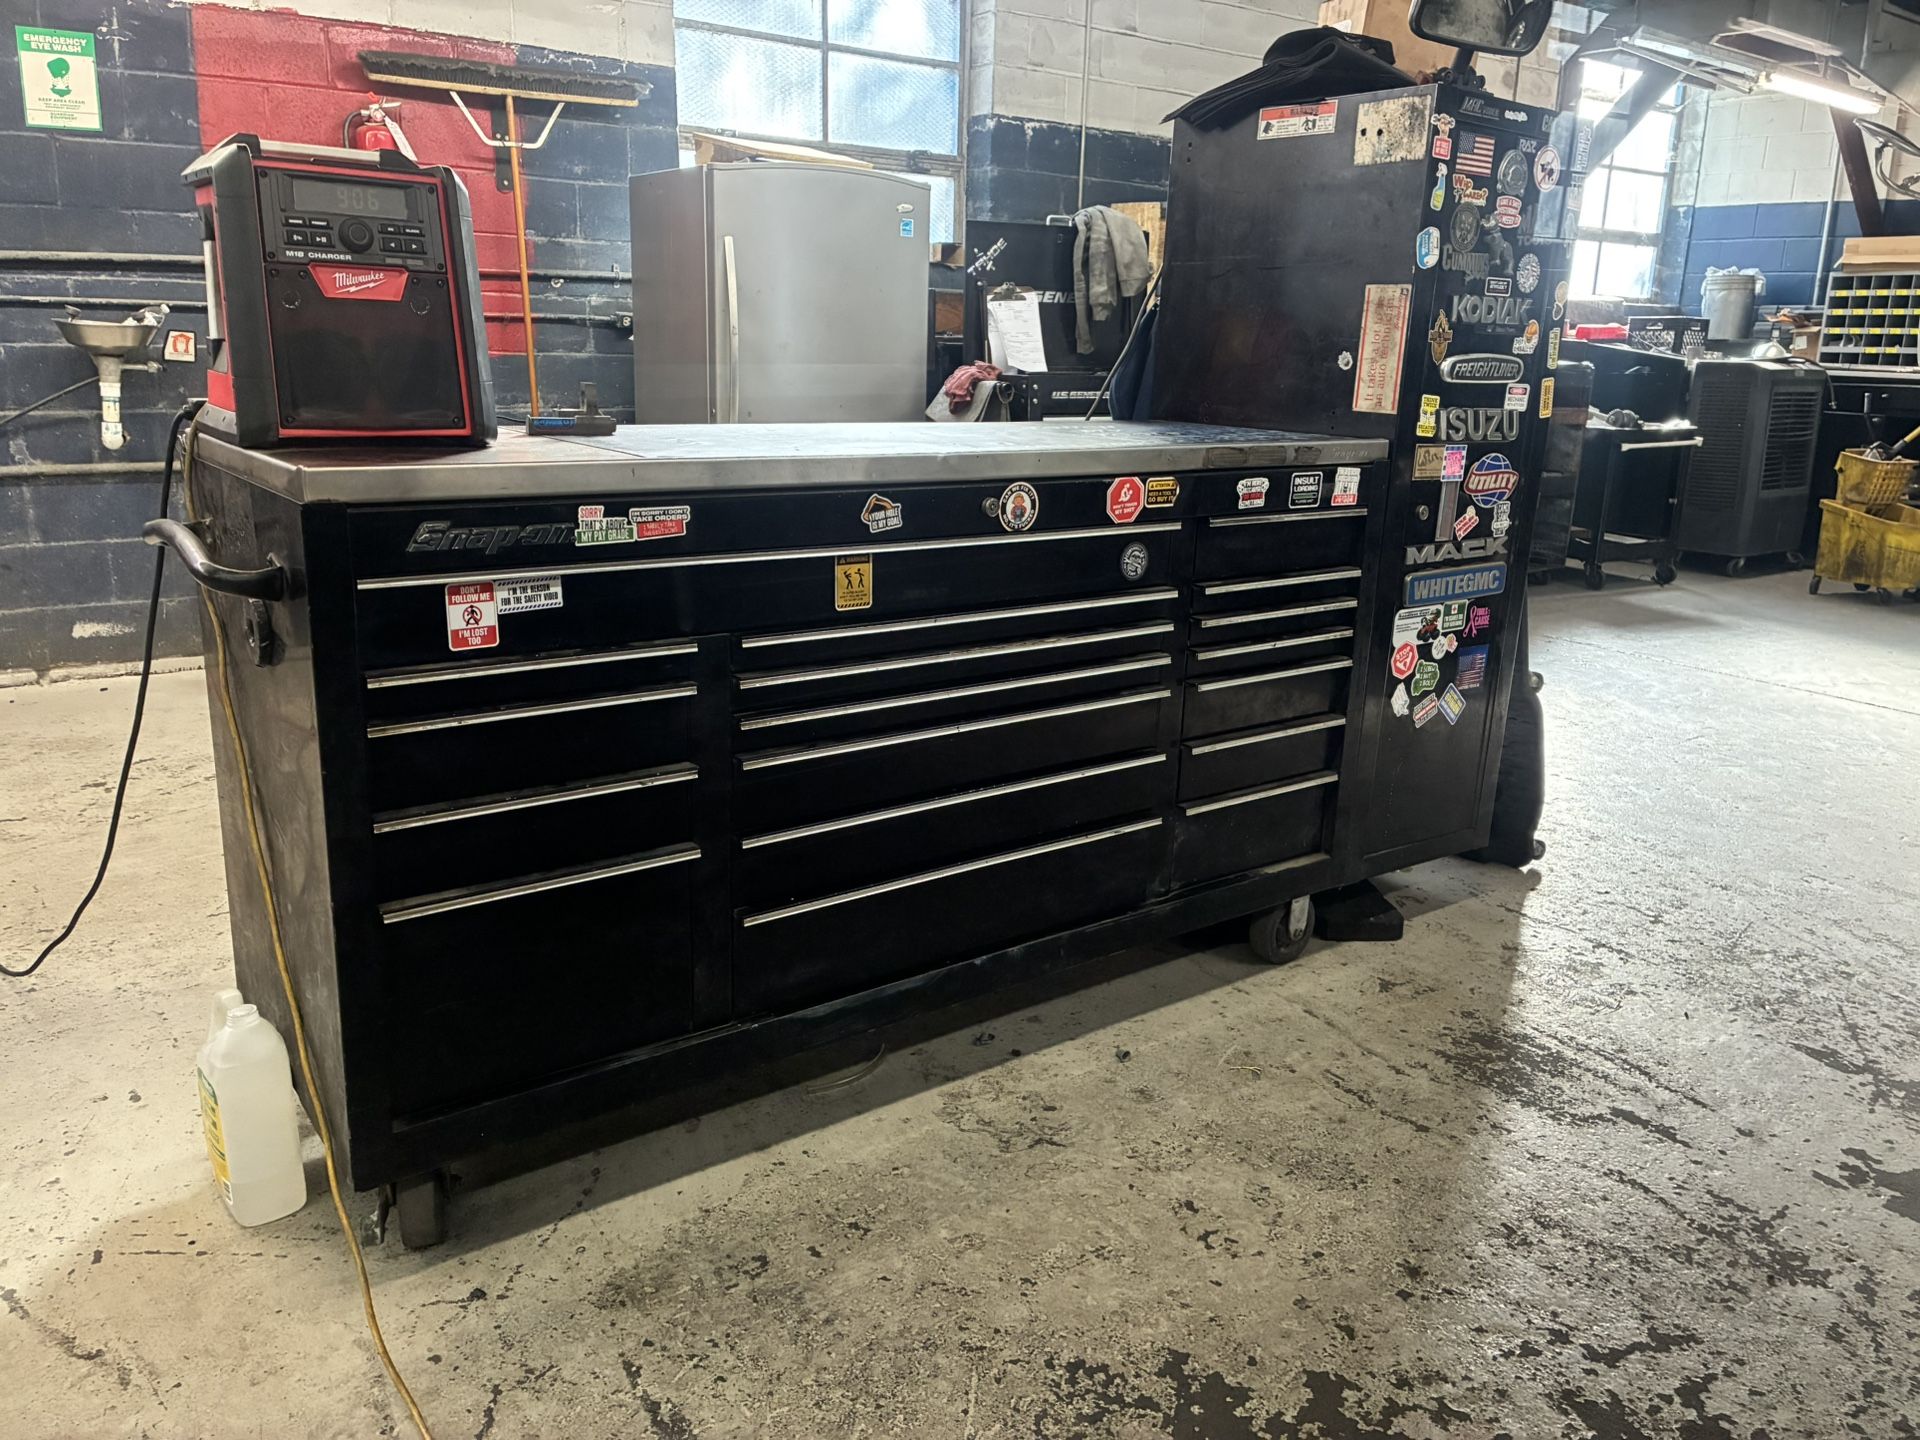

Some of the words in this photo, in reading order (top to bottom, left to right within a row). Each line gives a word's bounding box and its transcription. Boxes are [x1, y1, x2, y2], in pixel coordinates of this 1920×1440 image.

[23, 33, 87, 46] EMERGENCY
[30, 42, 51, 50] EYE
[52, 43, 82, 53] WASH
[308, 251, 352, 260] CHARGER
[332, 271, 385, 288] Milwaukee
[1452, 294, 1533, 325] KODIAK
[1454, 361, 1520, 377] FREIGHTLINER
[1439, 407, 1520, 441] ISUZU
[1294, 476, 1320, 485] INSULT
[1468, 474, 1517, 490] UTILITY
[1002, 490, 1012, 504] CAN
[1020, 485, 1029, 493] FIX
[1293, 485, 1318, 493] LOADING
[580, 507, 602, 518] SORRY
[870, 510, 886, 520] YOUR
[885, 508, 899, 518] HOLE
[1019, 509, 1035, 528] FUCKED
[580, 520, 604, 531] THAT'S
[606, 519, 625, 529] ABOVE
[872, 521, 878, 530] IS
[878, 519, 887, 528] MY
[887, 517, 900, 526] GOAL
[581, 531, 592, 542] MY
[594, 530, 605, 541] PAY
[608, 529, 629, 540] GRADE
[1405, 536, 1508, 565] MACK
[460, 585, 481, 594] DON'T
[508, 587, 518, 596] I'M
[519, 585, 529, 594] THE
[530, 583, 551, 593] REASON
[1414, 570, 1500, 600] WHITEGMC
[451, 593, 481, 604] FOLLOW
[481, 592, 491, 601] ME
[501, 597, 512, 607] FOR
[513, 596, 522, 605] THE
[523, 593, 542, 604] SAFETY
[543, 591, 559, 601] VIDEO
[458, 629, 471, 638] I'M
[471, 628, 488, 637] LOST
[467, 636, 482, 646] TOO
